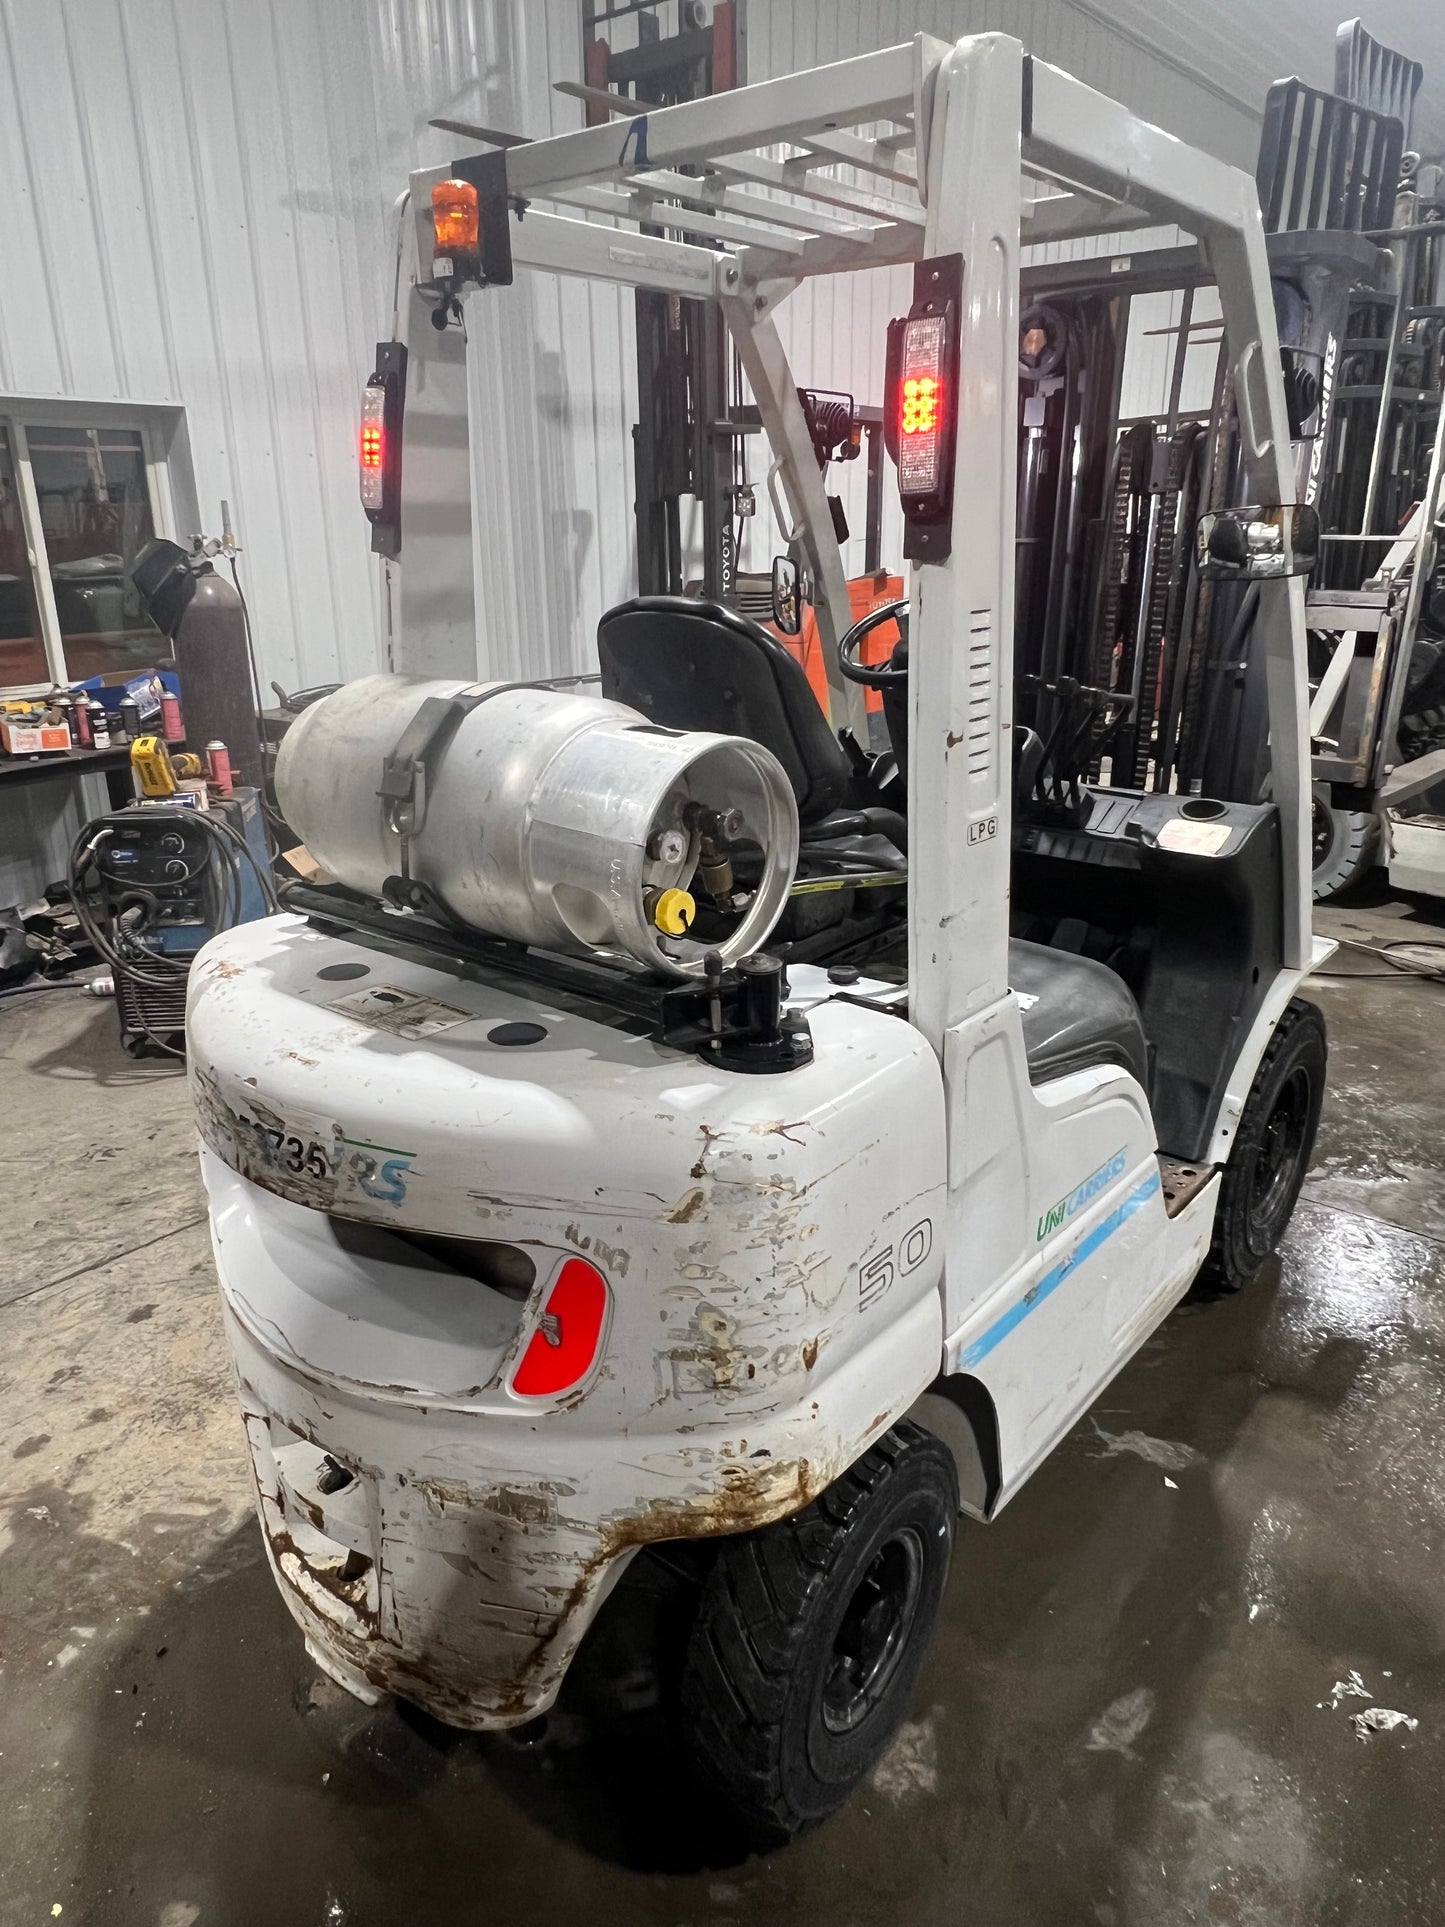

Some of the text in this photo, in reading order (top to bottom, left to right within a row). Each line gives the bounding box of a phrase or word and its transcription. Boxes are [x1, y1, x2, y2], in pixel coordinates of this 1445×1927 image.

[722, 524, 731, 592] TOYOTA
[970, 820, 996, 842] LPG
[858, 1217, 933, 1314] 50
